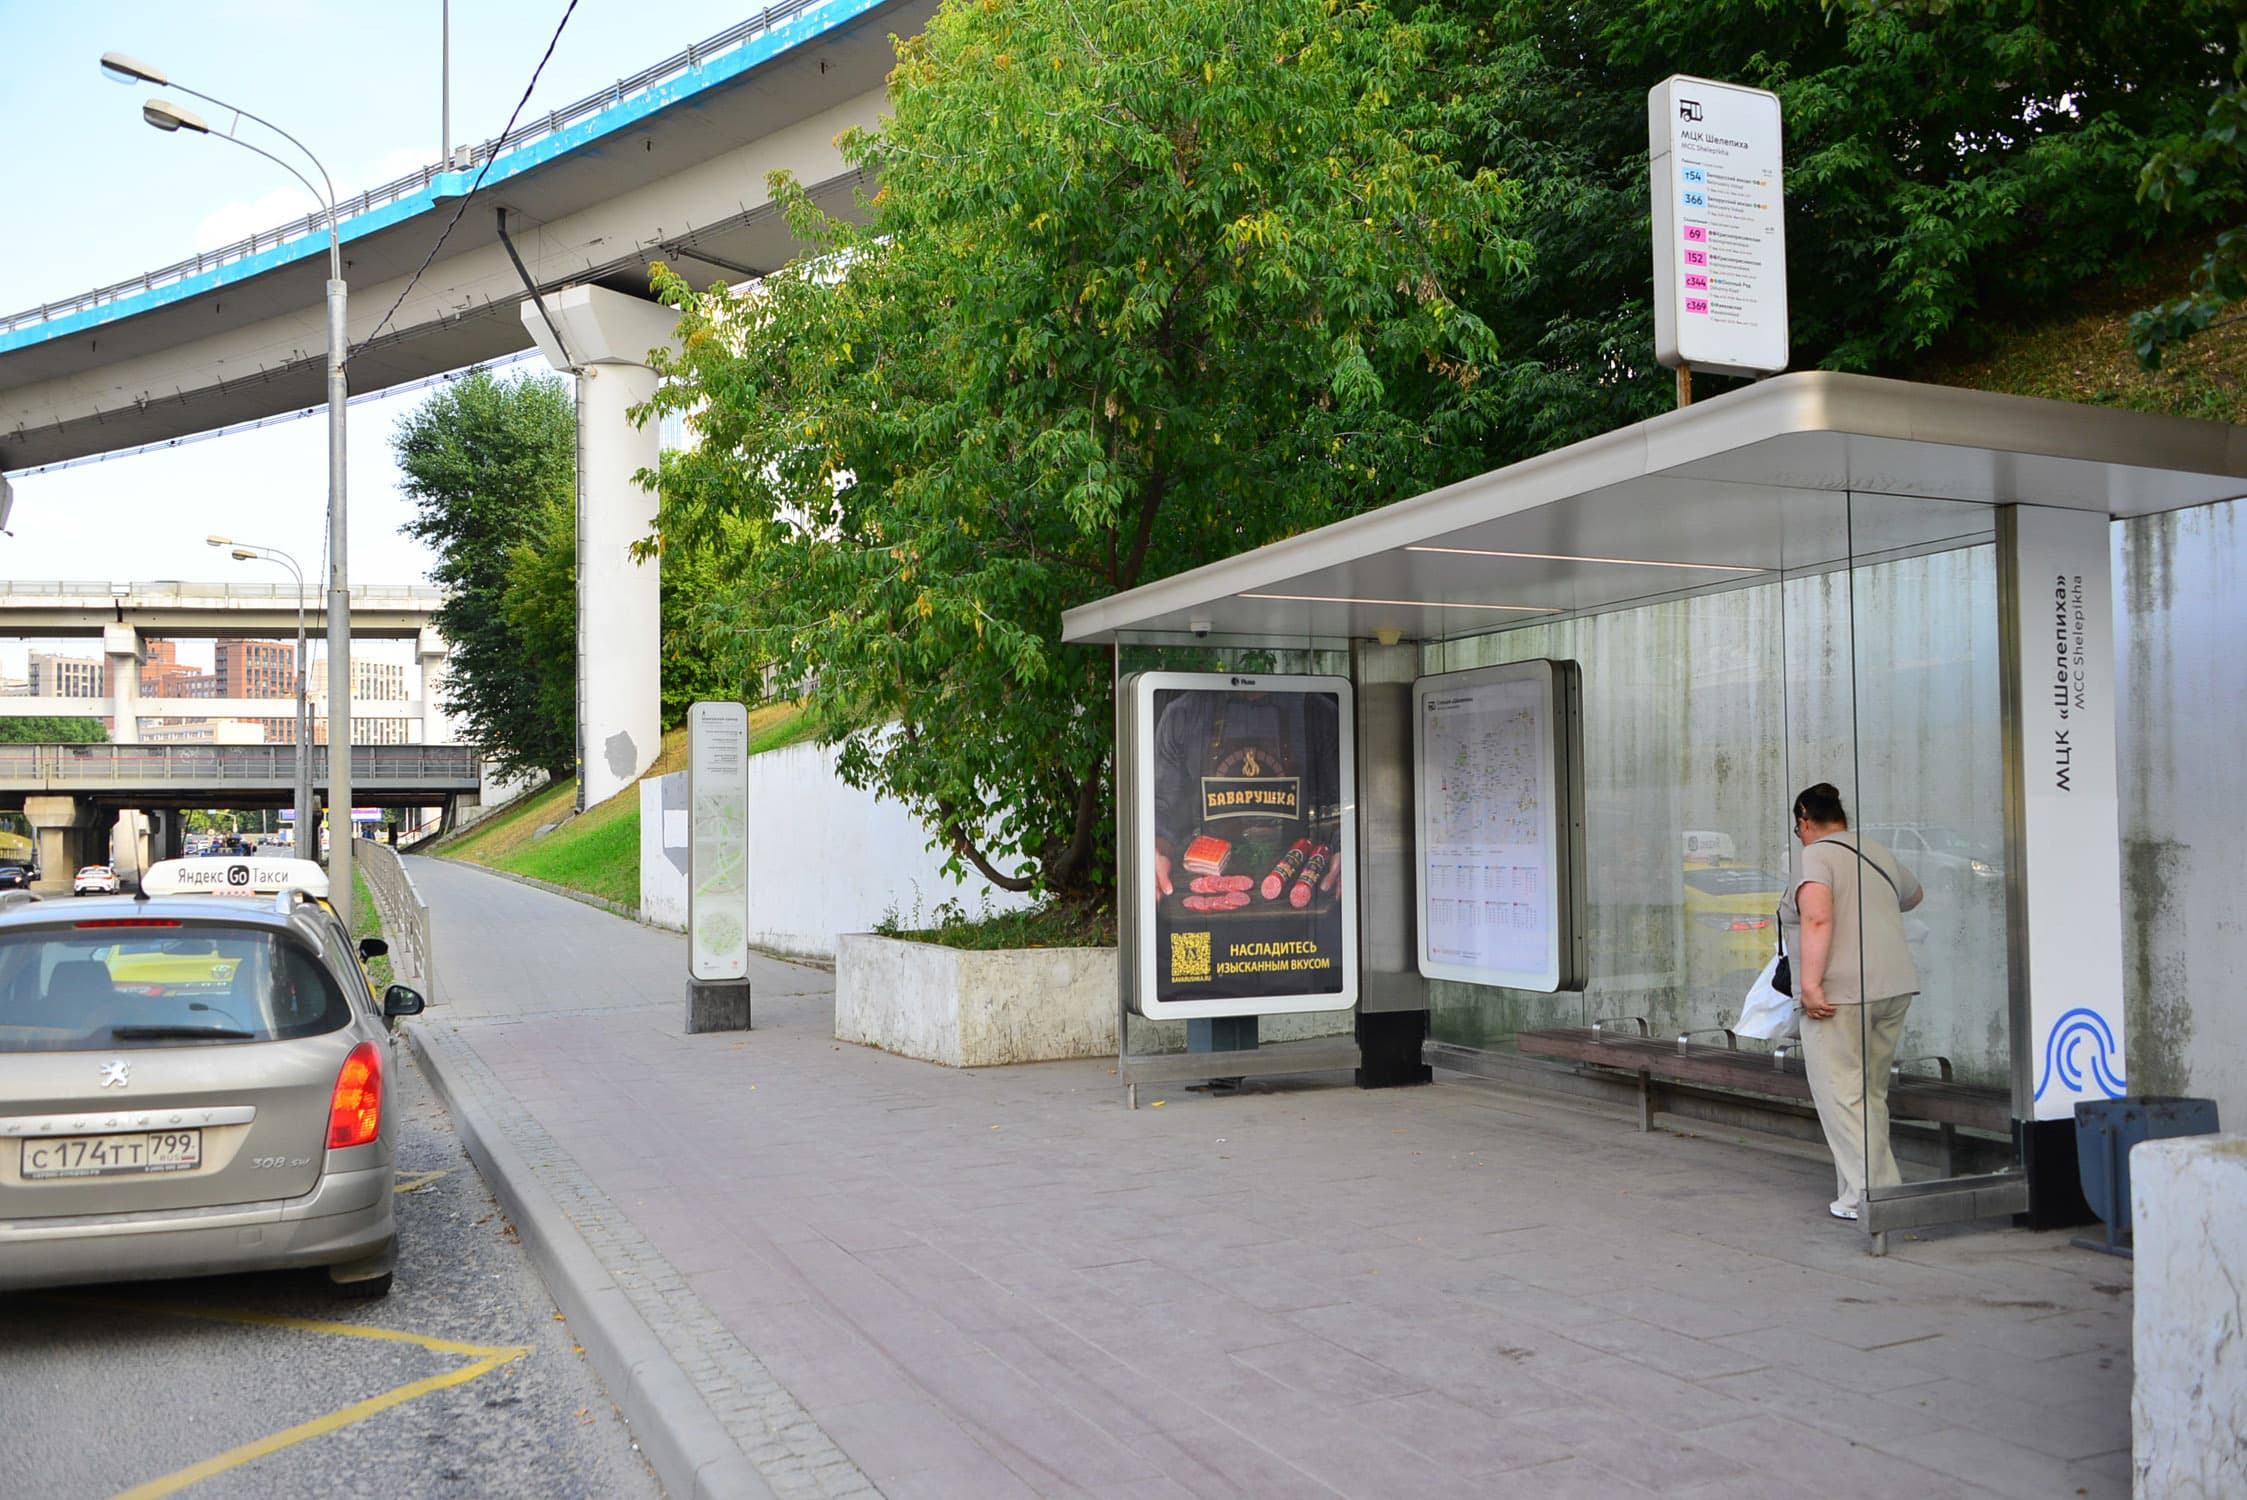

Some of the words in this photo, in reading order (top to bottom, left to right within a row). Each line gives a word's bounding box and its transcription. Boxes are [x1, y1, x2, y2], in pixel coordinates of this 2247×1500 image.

[1681, 130, 1704, 142] МЦК
[1705, 134, 1749, 149] Шелепиха
[1685, 193, 1703, 206] 366
[1689, 229, 1701, 239] 69
[1687, 252, 1703, 264] 152
[2071, 575, 2085, 666] Shelepikha
[2054, 575, 2069, 720] «Шелепиха»
[2072, 671, 2085, 710] MCC
[2055, 729, 2072, 792] МЦК
[1207, 790, 1296, 807] БАВАРУШКА
[178, 868, 225, 886] Яндекс
[229, 867, 248, 884] Go
[252, 867, 289, 883] Такси
[1230, 941, 1317, 957] НАСЛАДИТЕСЬ
[1216, 959, 1289, 974] ИЗЫСКАННЫМ
[1291, 957, 1330, 971] ВКУСОМ
[150, 1134, 192, 1155] 799
[250, 1157, 285, 1169] 308
